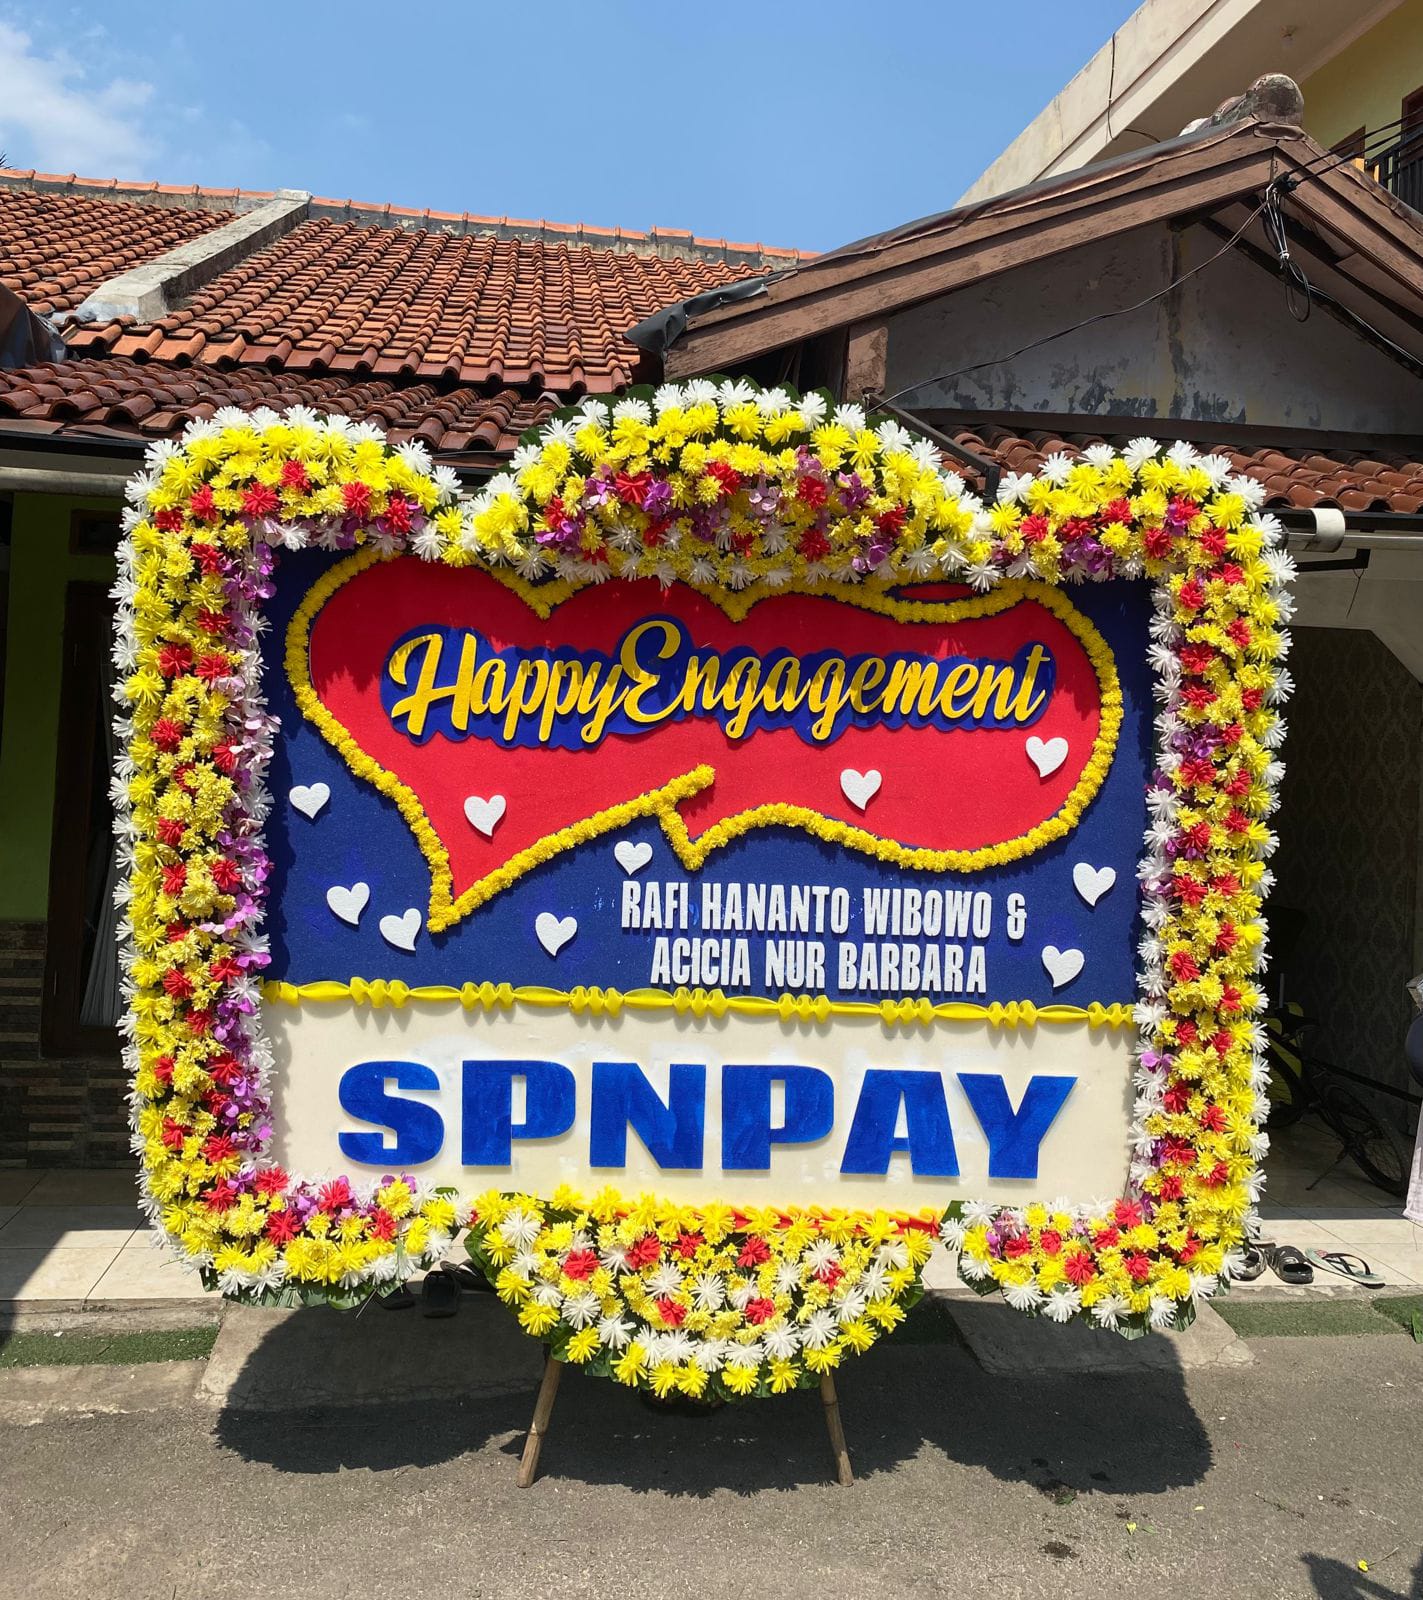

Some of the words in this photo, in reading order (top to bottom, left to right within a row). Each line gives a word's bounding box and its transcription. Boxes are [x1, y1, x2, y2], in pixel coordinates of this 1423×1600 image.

[388, 632, 631, 743] Happy
[620, 620, 1048, 740] Engagement
[621, 881, 689, 930] RAFI
[701, 883, 850, 935] HANANTO
[863, 887, 993, 938] WIBOWO
[1006, 893, 1027, 940] &
[650, 937, 751, 987] ACICIA
[765, 939, 826, 989] NUR
[838, 941, 987, 993] BARBARA
[338, 1060, 1078, 1179] SPNPAY
